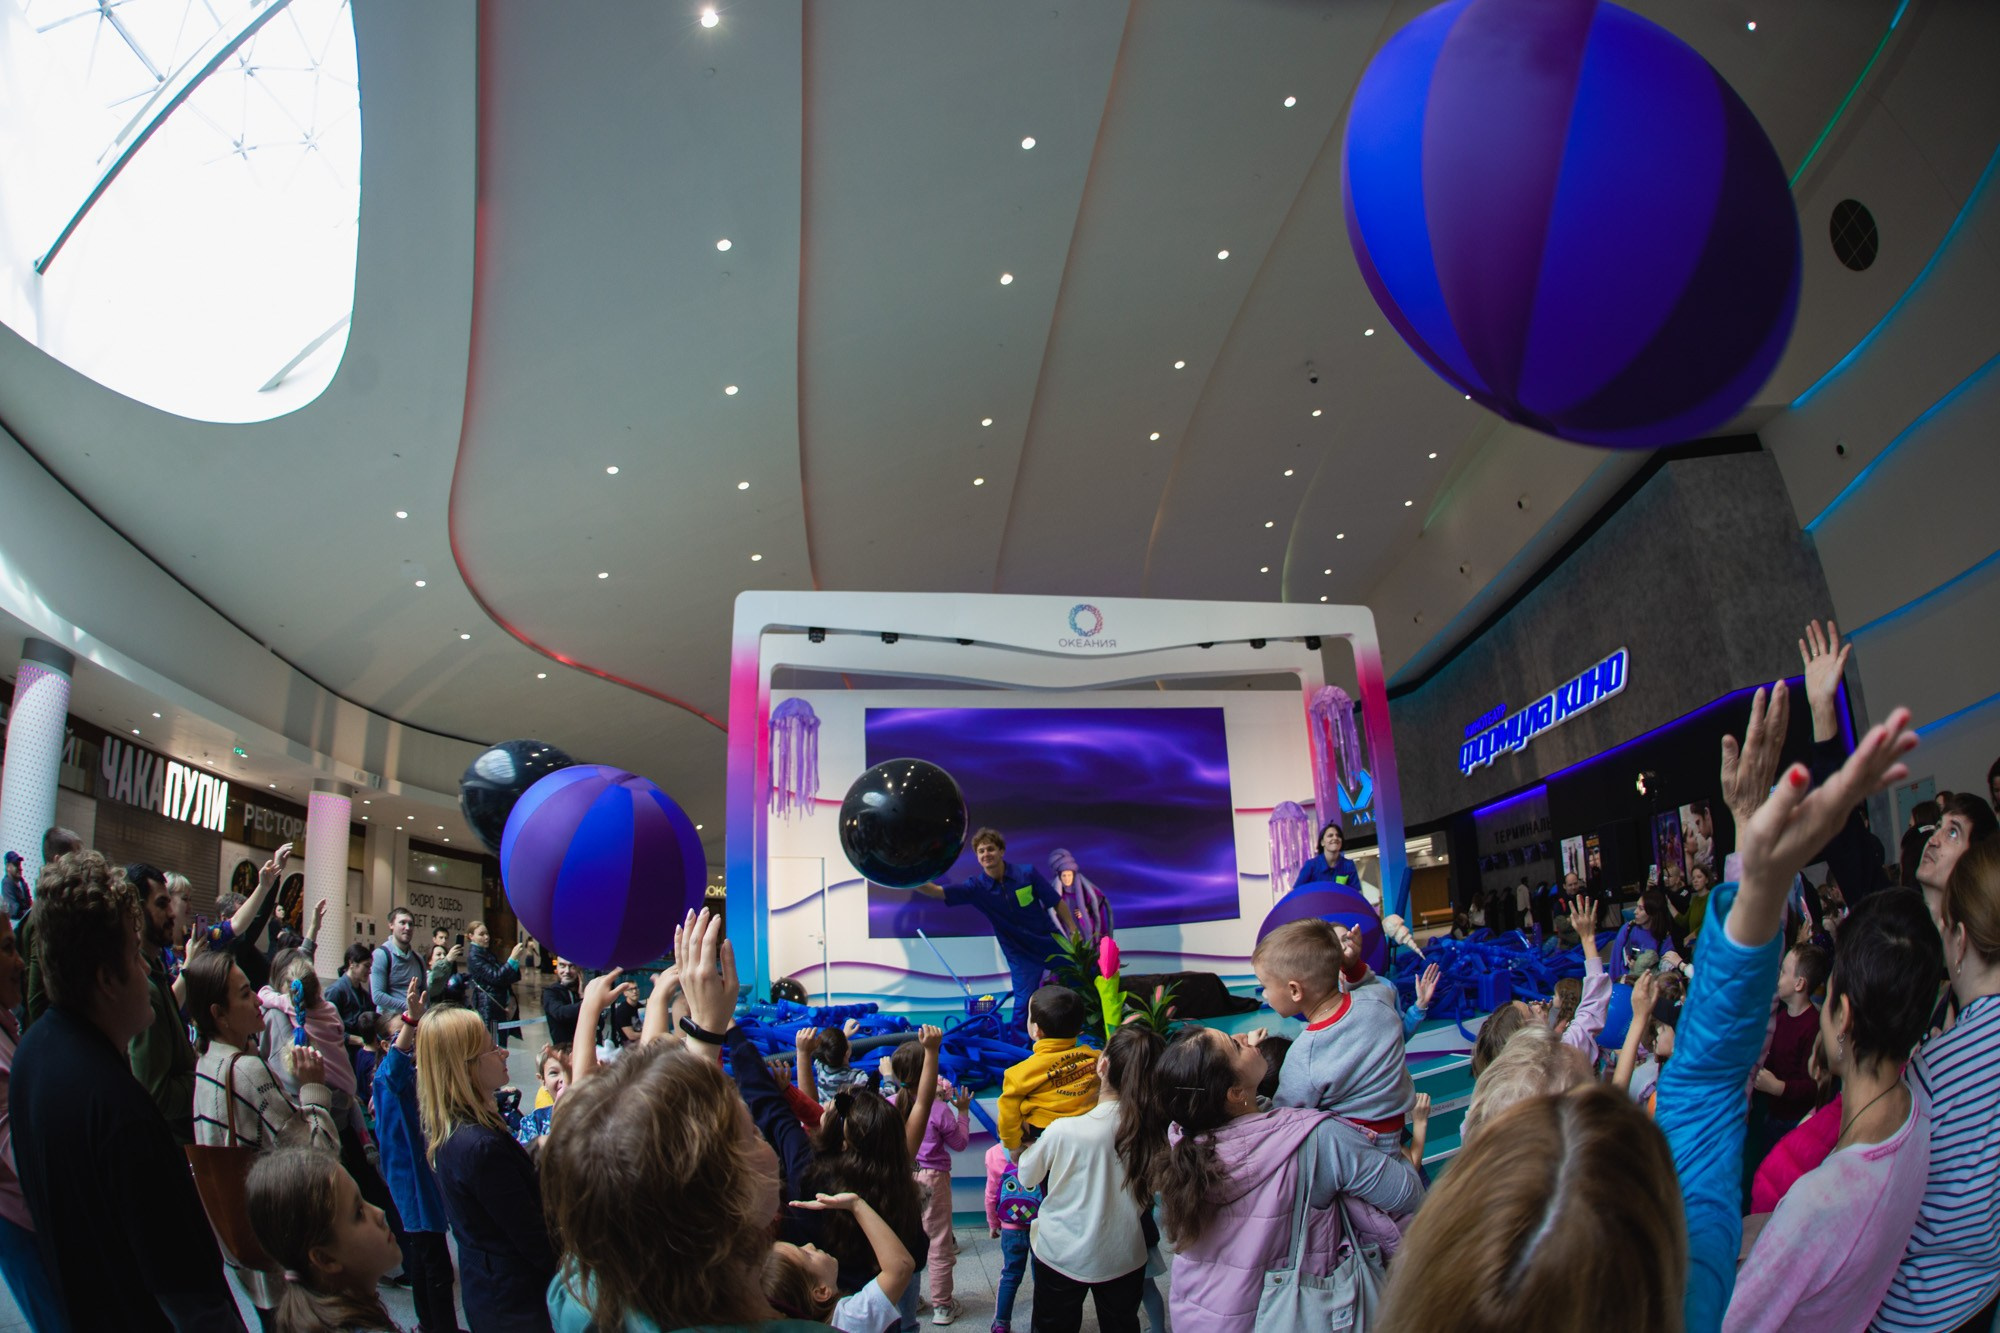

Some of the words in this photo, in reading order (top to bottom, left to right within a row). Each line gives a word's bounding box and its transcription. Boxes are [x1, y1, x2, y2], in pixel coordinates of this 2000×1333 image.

[1058, 638, 1117, 648] ОКЕАНИЯ
[1464, 703, 1507, 739] КИНОТЕАТР
[102, 736, 228, 832] ЧАКАПУЛИ
[410, 892, 435, 909] СКОРО
[438, 896, 463, 912] ЗДЕСЬ
